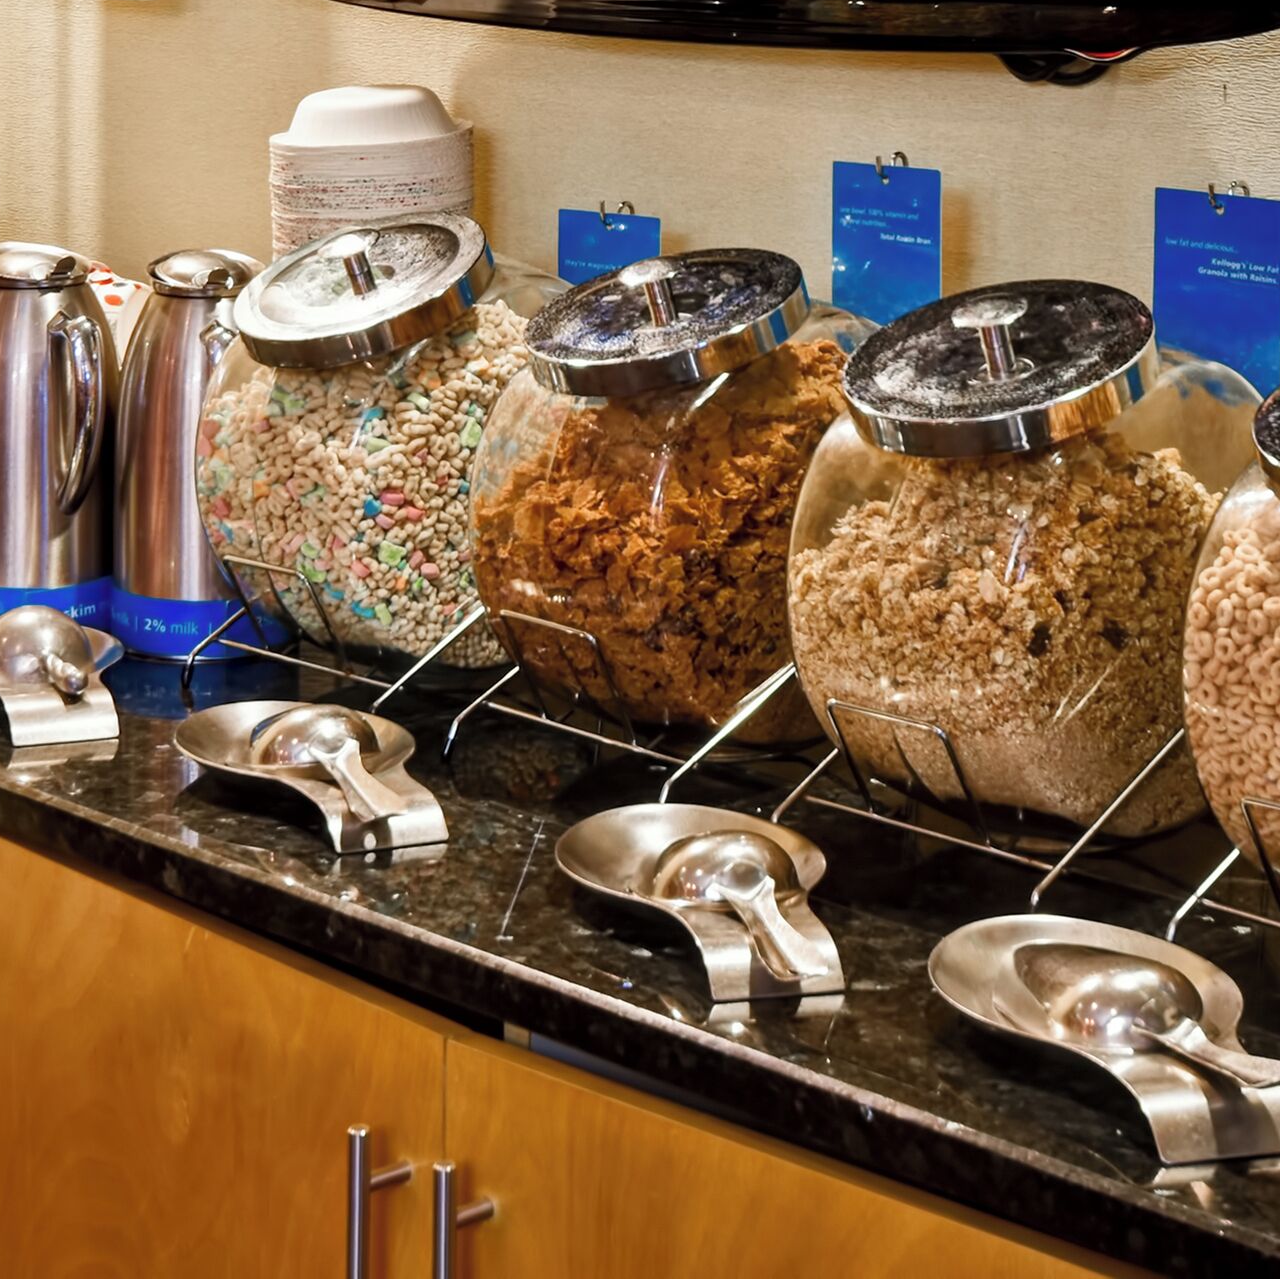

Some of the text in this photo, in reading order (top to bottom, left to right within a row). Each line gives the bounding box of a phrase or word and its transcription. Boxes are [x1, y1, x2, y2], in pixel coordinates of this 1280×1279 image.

[1198, 266, 1228, 277] Granola
[1230, 270, 1248, 280] with
[1248, 263, 1265, 272] Low
[1266, 265, 1280, 274] Fat
[144, 618, 198, 635] 2% milk
